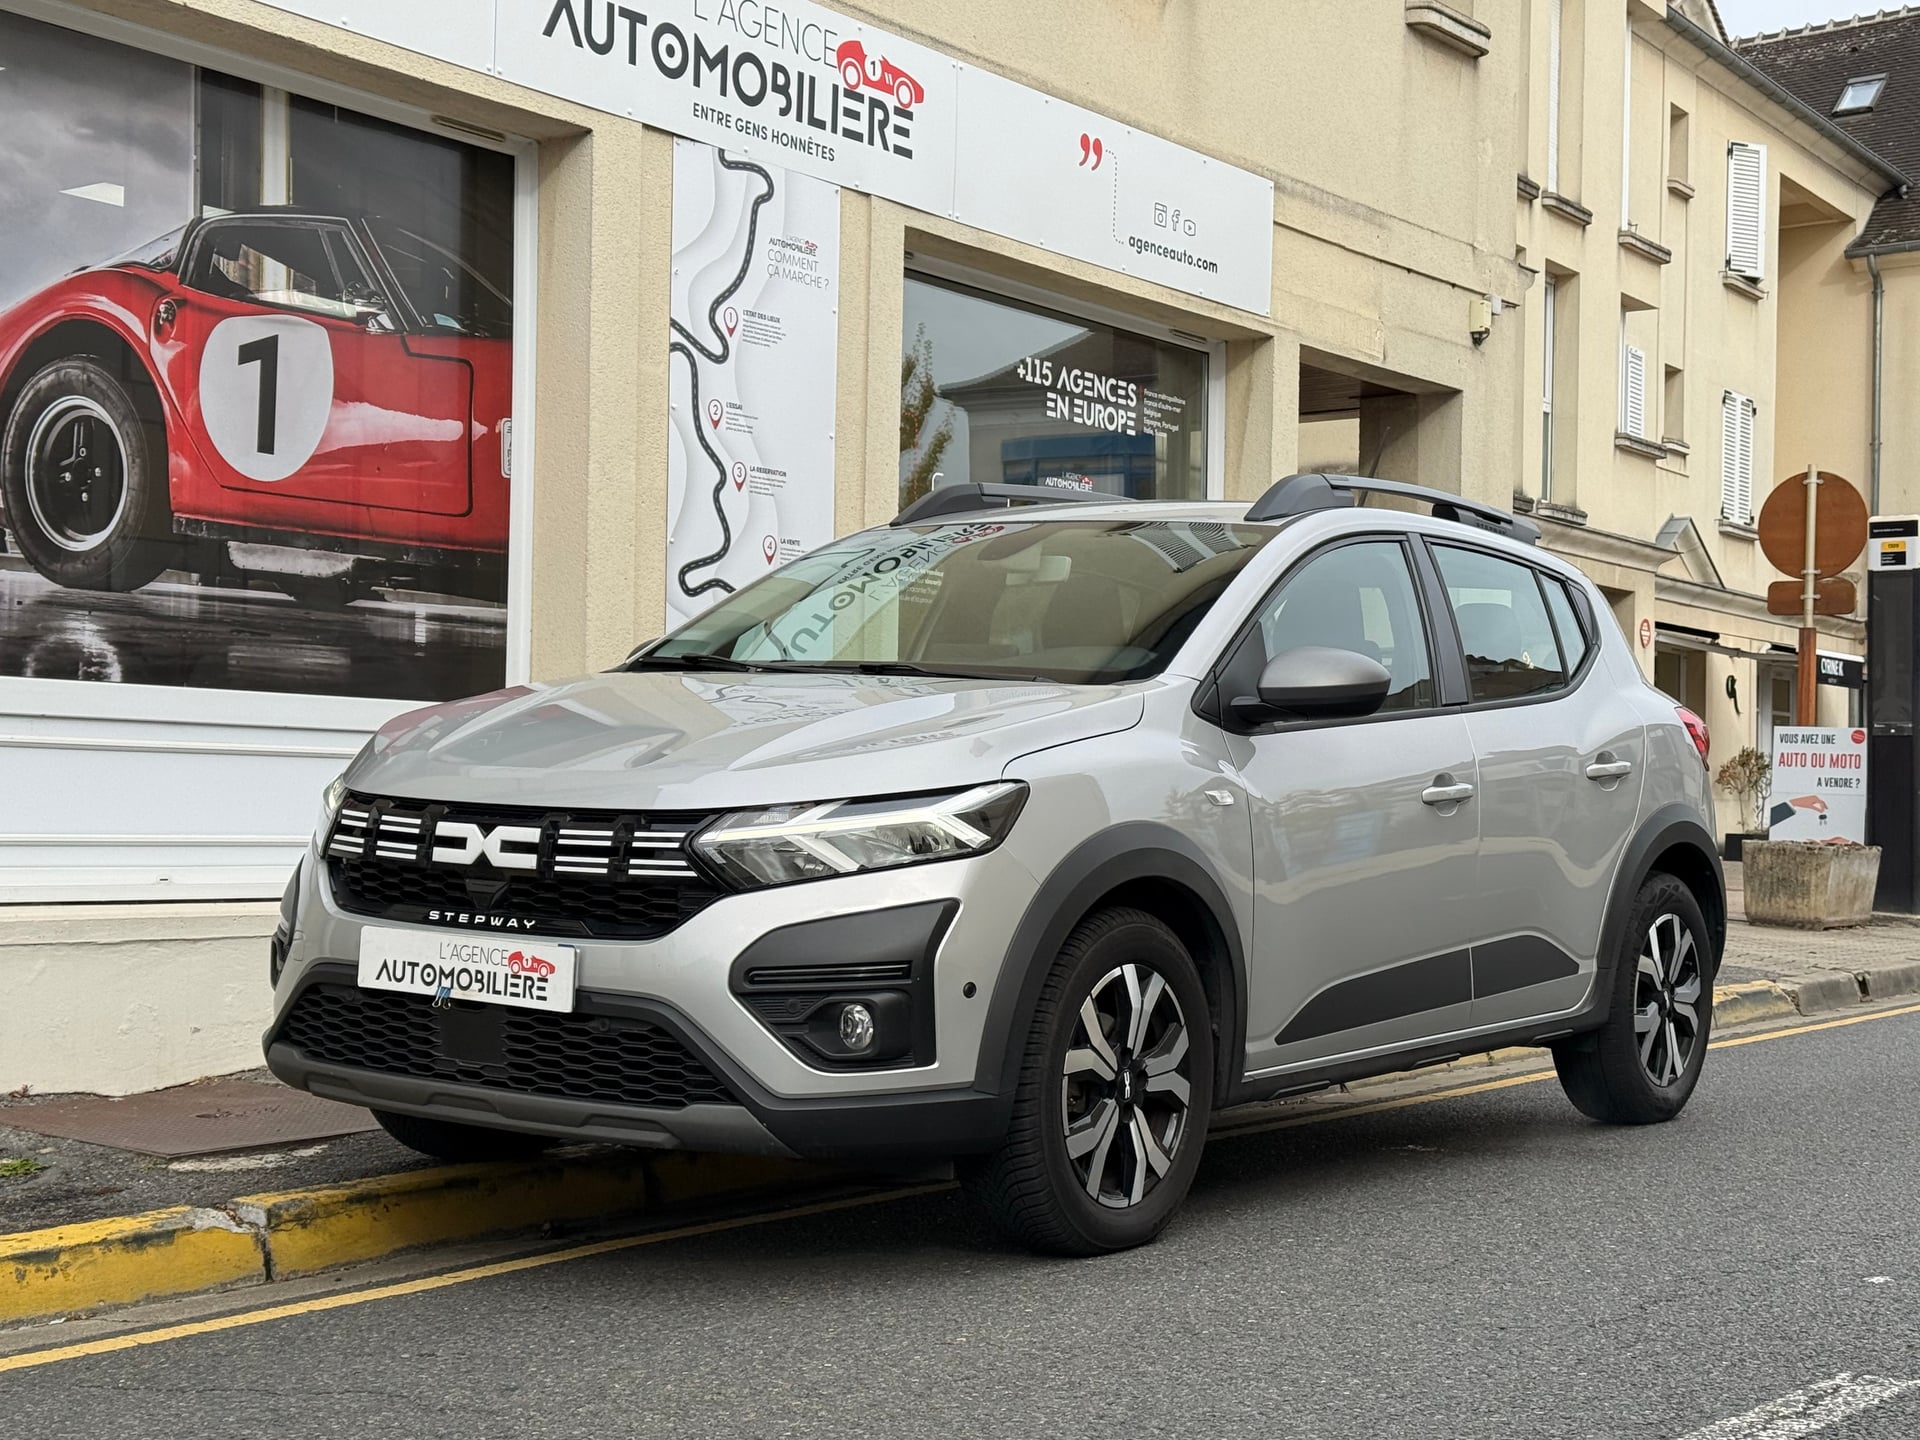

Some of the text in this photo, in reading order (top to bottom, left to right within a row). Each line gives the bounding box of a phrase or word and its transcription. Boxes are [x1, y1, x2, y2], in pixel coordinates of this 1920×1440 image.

[693, 102, 836, 162] ENTRE GENS HONNÊTES
[767, 248, 819, 273] COMMENT
[1128, 235, 1218, 274] agenceauto.com
[766, 263, 830, 290] ÇA MARCHE ?
[1017, 356, 1137, 408] +115 AGENCES
[238, 334, 279, 456] 1
[713, 404, 719, 415] 2
[1046, 391, 1137, 436] EN EUROPE
[736, 466, 743, 478] 3
[767, 540, 773, 550] 4
[1779, 733, 1836, 745] VOUS AVEZ UNE
[1778, 752, 1861, 769] AUTO OU MOTO
[1816, 777, 1861, 789] A VENDRE ?
[428, 910, 536, 929] STEPWAY
[439, 942, 509, 967] L'AGENCE
